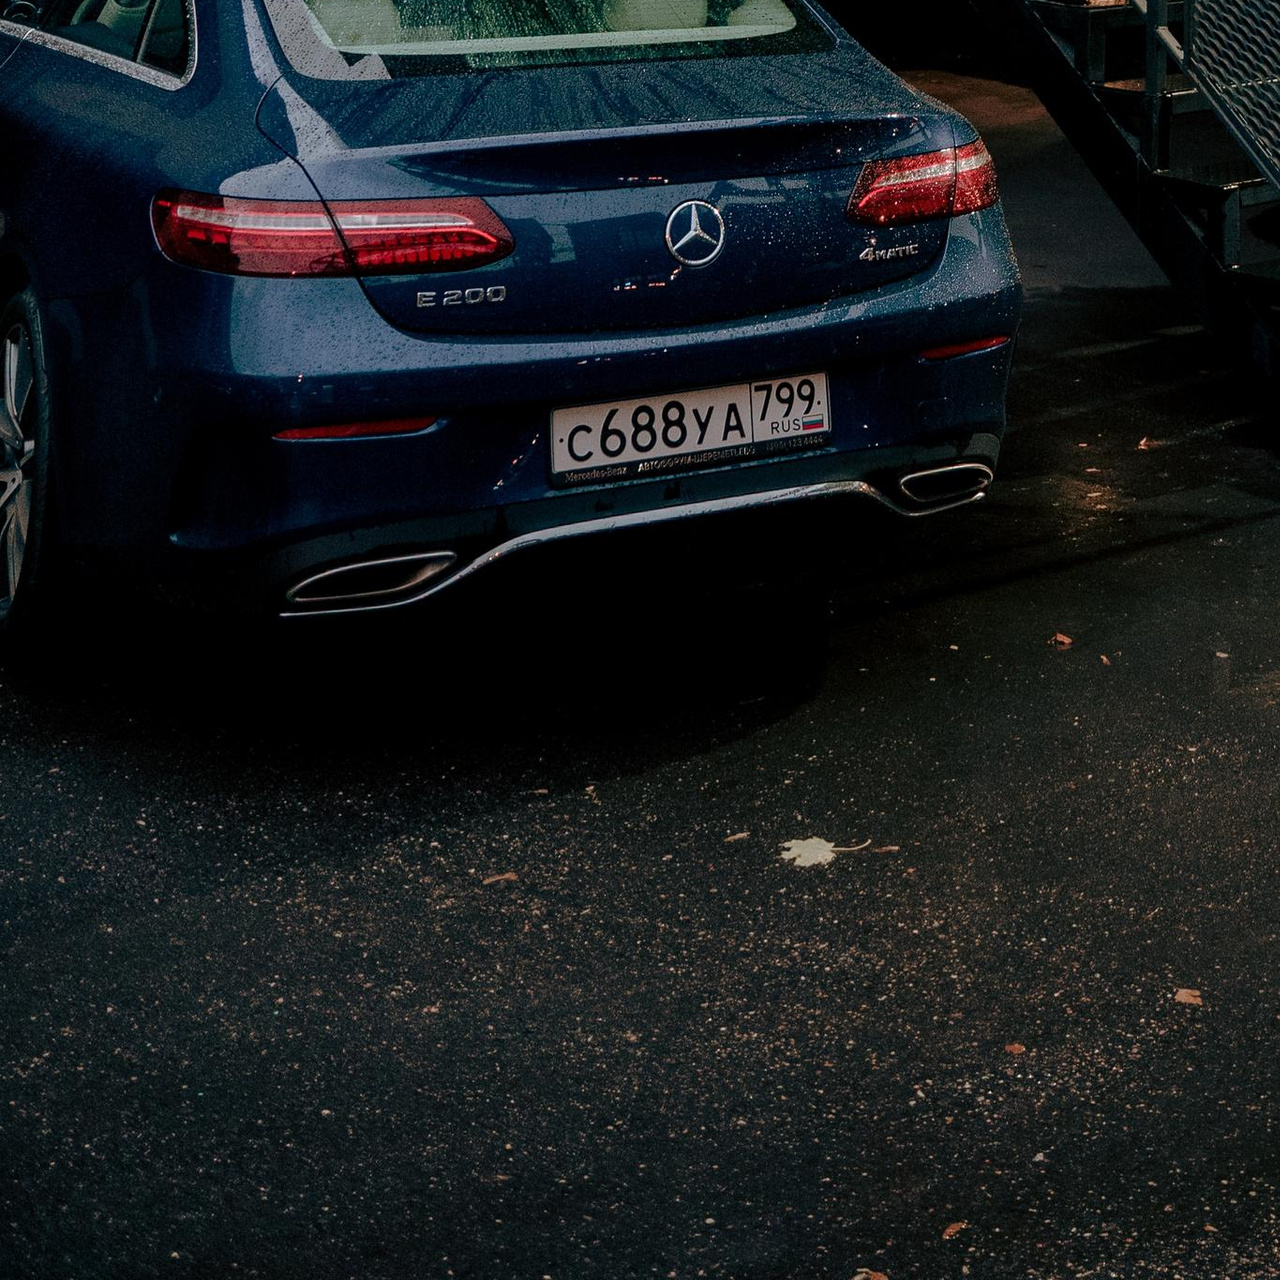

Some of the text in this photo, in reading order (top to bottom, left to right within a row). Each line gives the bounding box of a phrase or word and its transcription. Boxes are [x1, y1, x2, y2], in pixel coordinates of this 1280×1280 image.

[859, 244, 919, 261] 4MATIC
[416, 286, 506, 308] E 200
[754, 379, 815, 421] 799
[770, 418, 801, 434] RUS
[565, 466, 628, 482] Mercedes-Benz
